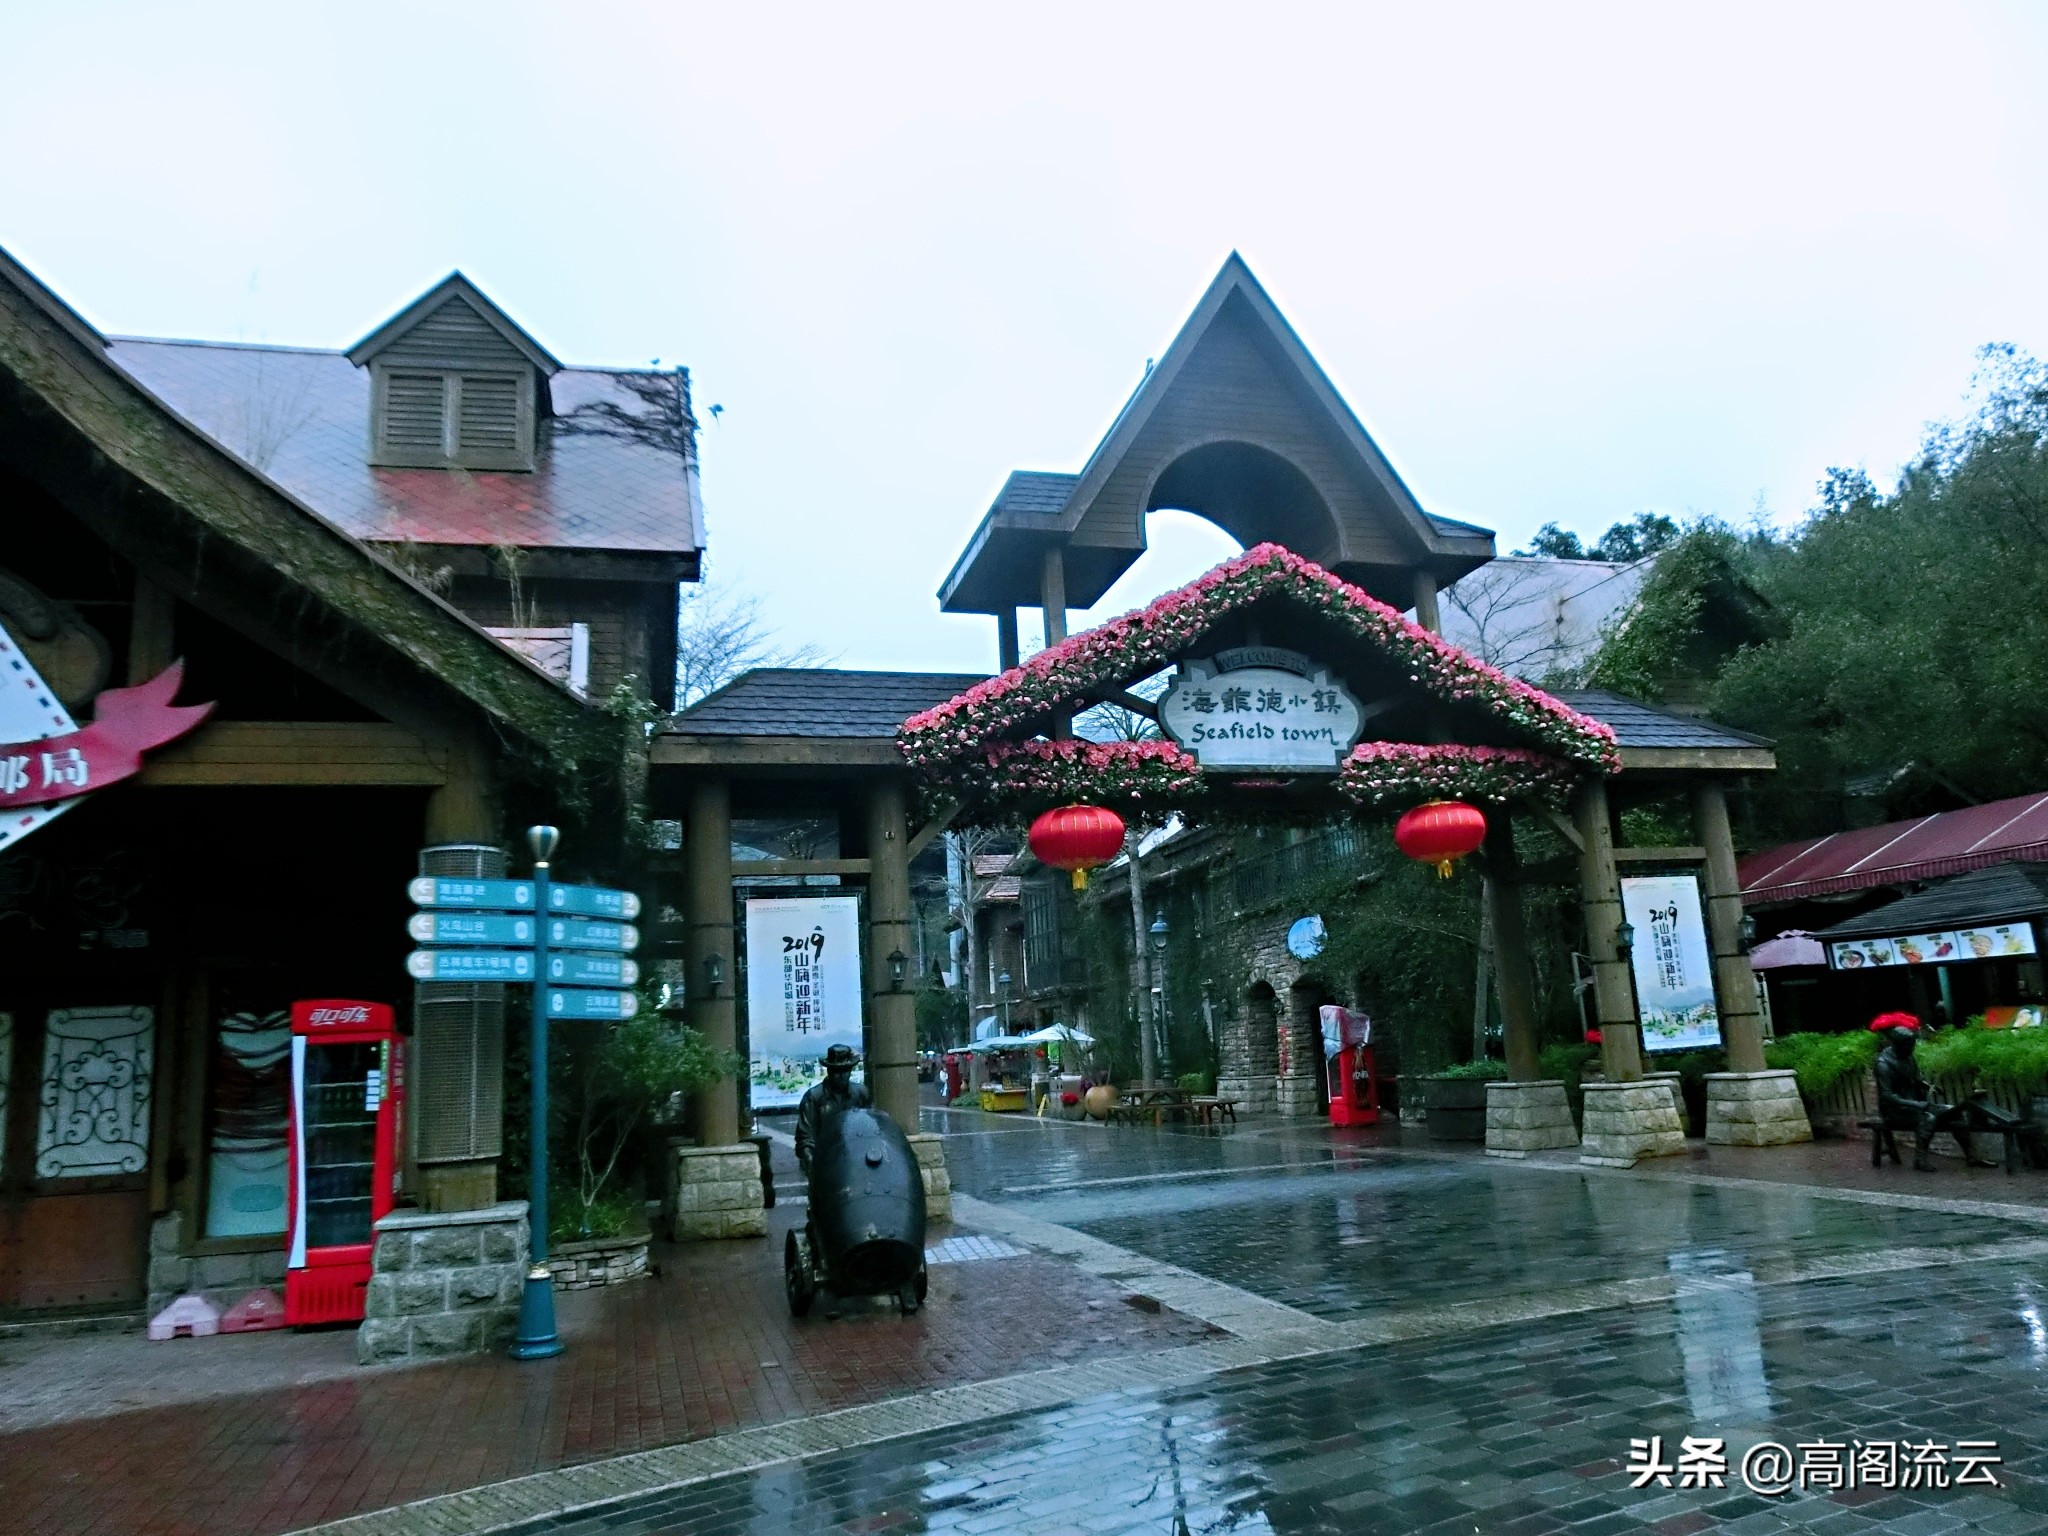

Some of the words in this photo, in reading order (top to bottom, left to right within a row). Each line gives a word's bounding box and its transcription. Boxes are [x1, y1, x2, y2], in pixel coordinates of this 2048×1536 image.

[1219, 651, 1286, 671] WELCOME
[1192, 722, 1275, 743] Seafield
[1282, 725, 1339, 746] town
[1649, 906, 1678, 932] 2019
[782, 932, 825, 964] 2019
[794, 952, 812, 1035] 山嗨迎新年
